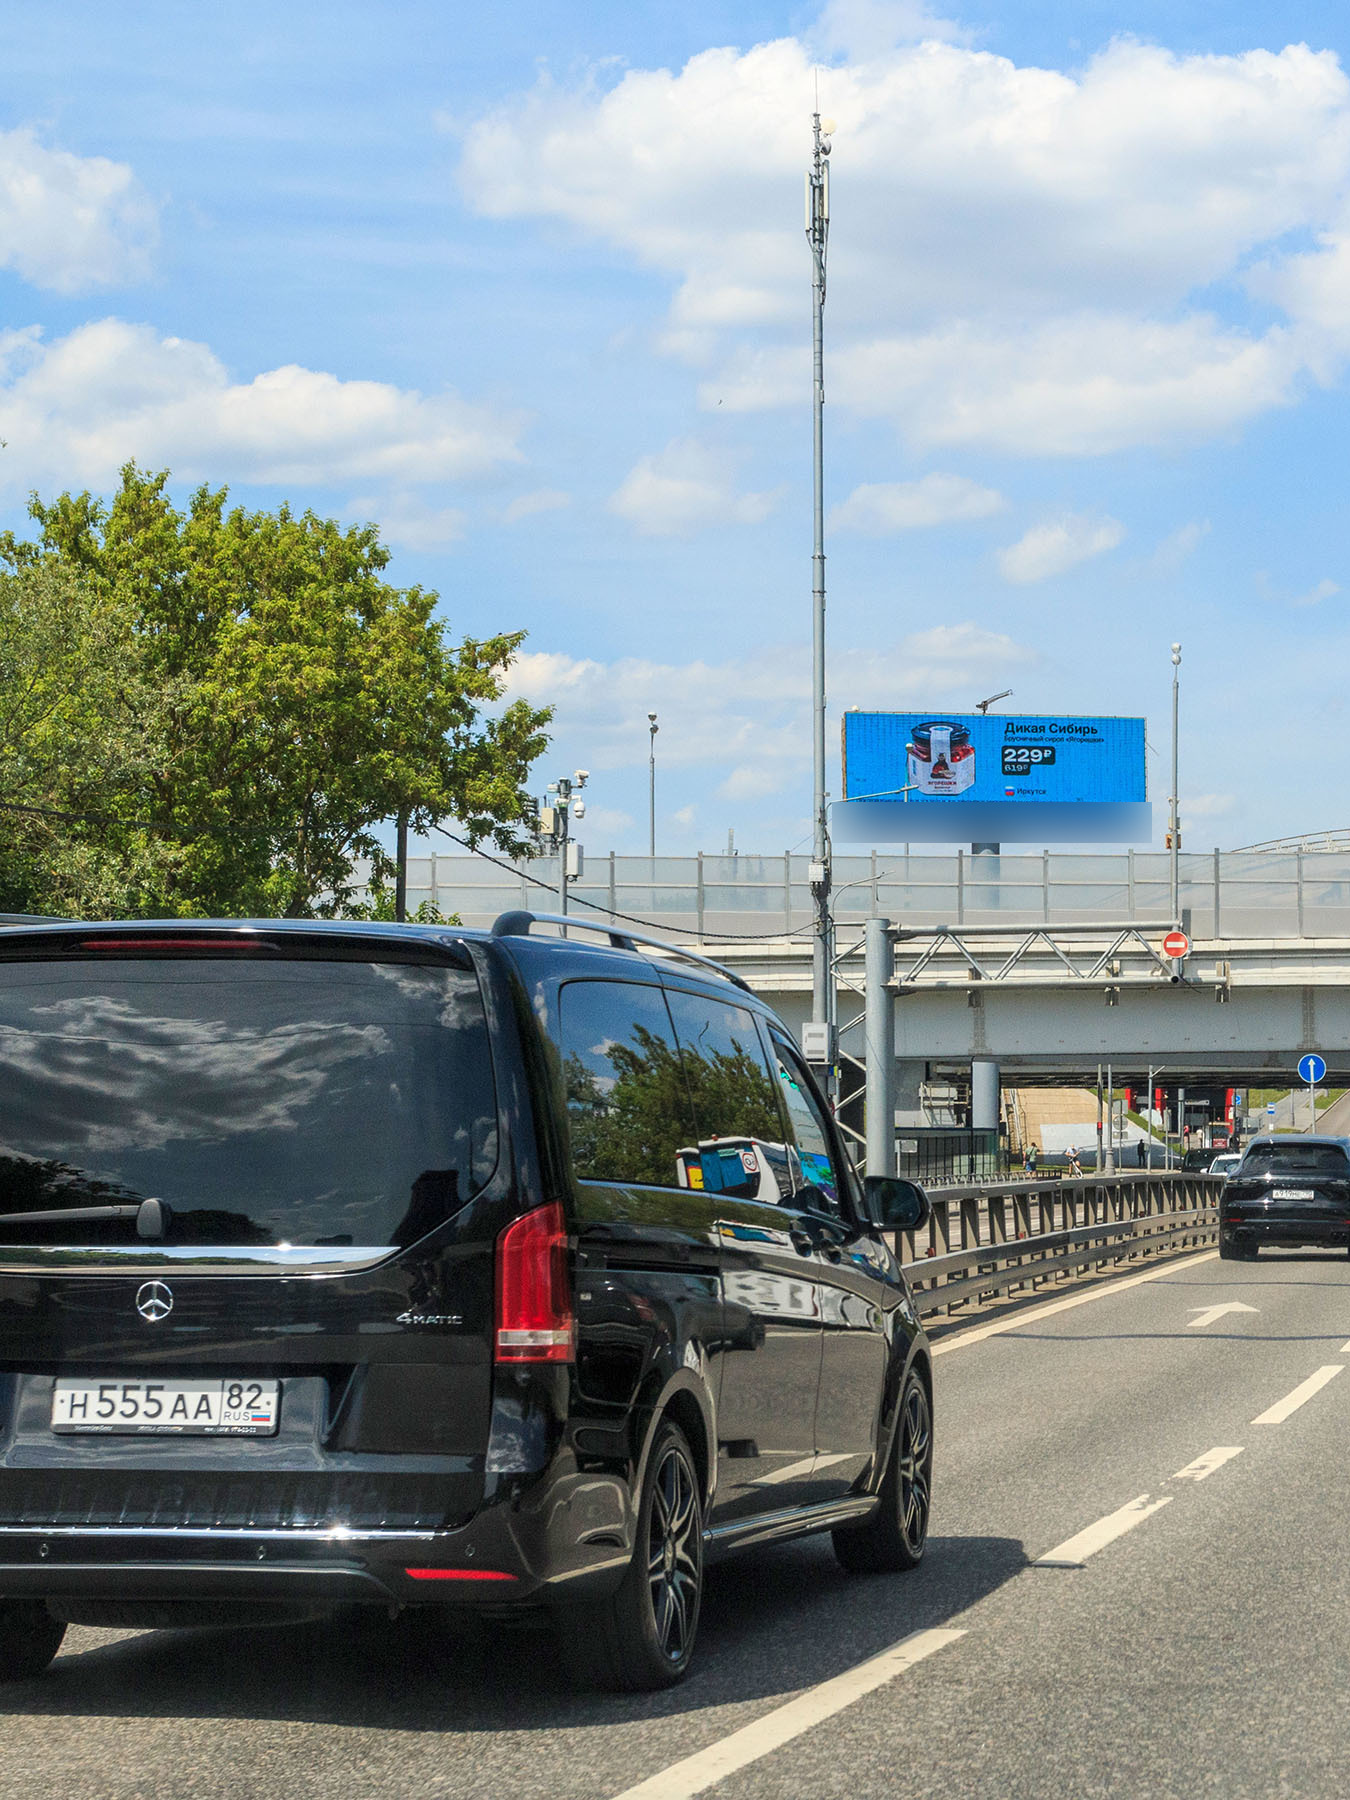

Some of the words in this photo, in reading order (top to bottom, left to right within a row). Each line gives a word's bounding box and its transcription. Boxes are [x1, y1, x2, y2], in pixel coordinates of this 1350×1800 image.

[1004, 722, 1046, 735] Дикая
[1049, 723, 1098, 736] Сибирь
[396, 1312, 463, 1324] 4MATIC
[226, 1383, 263, 1410] 82
[223, 1411, 250, 1421] RUS
